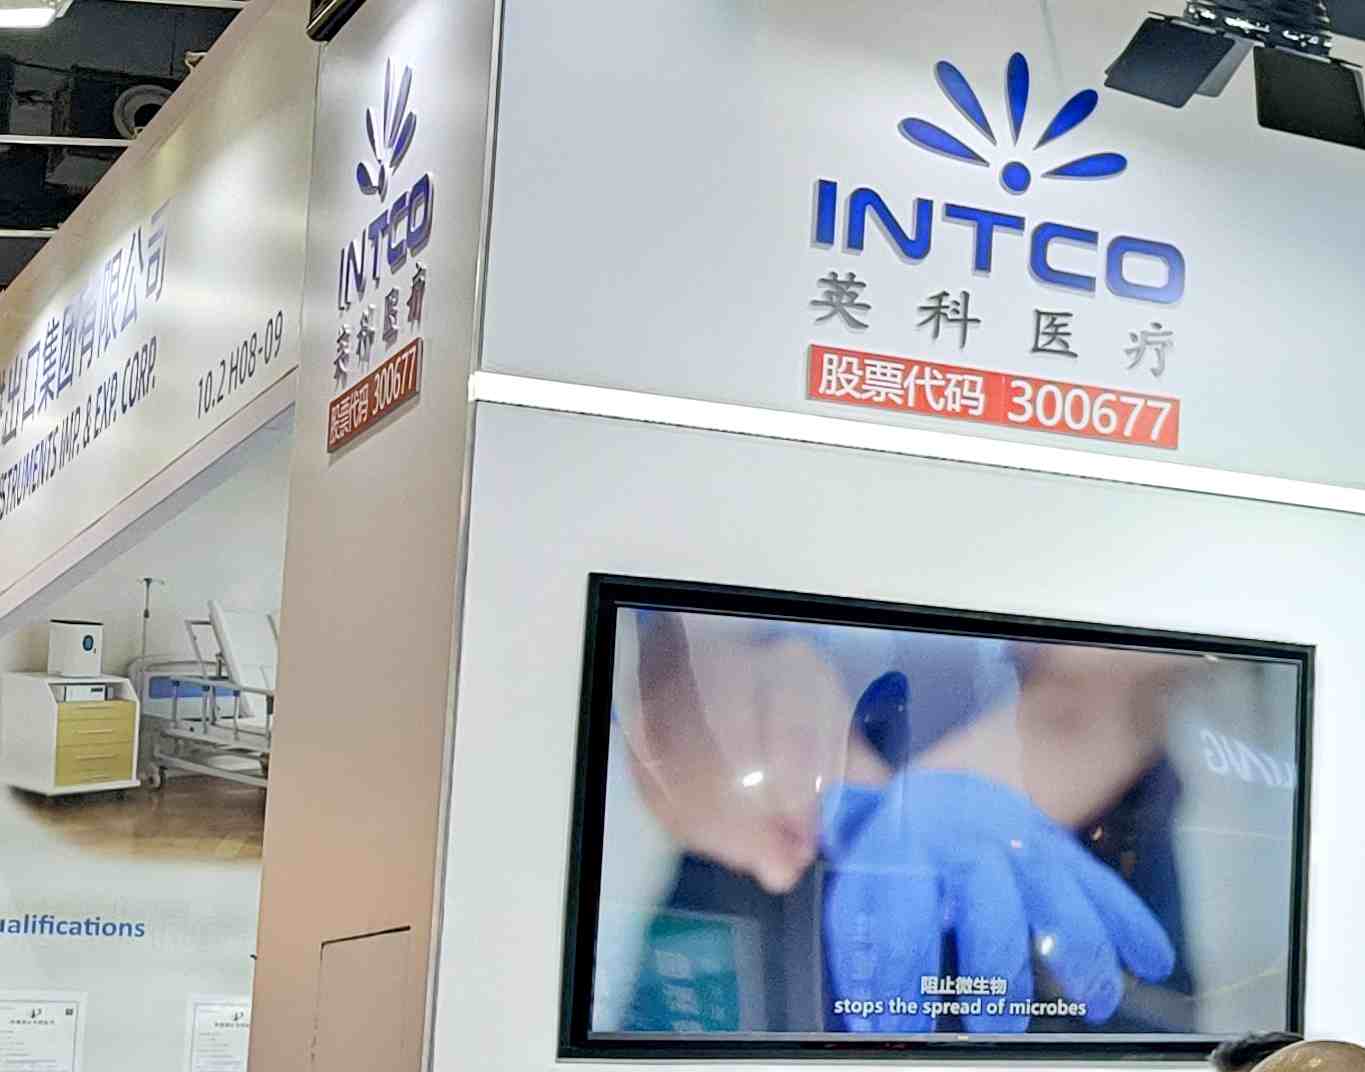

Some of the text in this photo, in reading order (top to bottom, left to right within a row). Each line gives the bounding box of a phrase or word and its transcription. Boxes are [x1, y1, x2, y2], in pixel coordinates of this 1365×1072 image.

[338, 174, 434, 311] INTCO
[811, 178, 1185, 303] INTCO
[0, 210, 169, 446] 出口集团有限公司
[810, 271, 1176, 377] 英科医疗
[82, 404, 91, 449] &
[93, 377, 119, 440] EXP.
[120, 336, 158, 414] CORP.
[373, 344, 418, 417] 300677
[817, 354, 1172, 443] 股票代码 300677
[834, 998, 1087, 1018] stops the spread of microbes
[920, 975, 1008, 996] 阻止微生物
